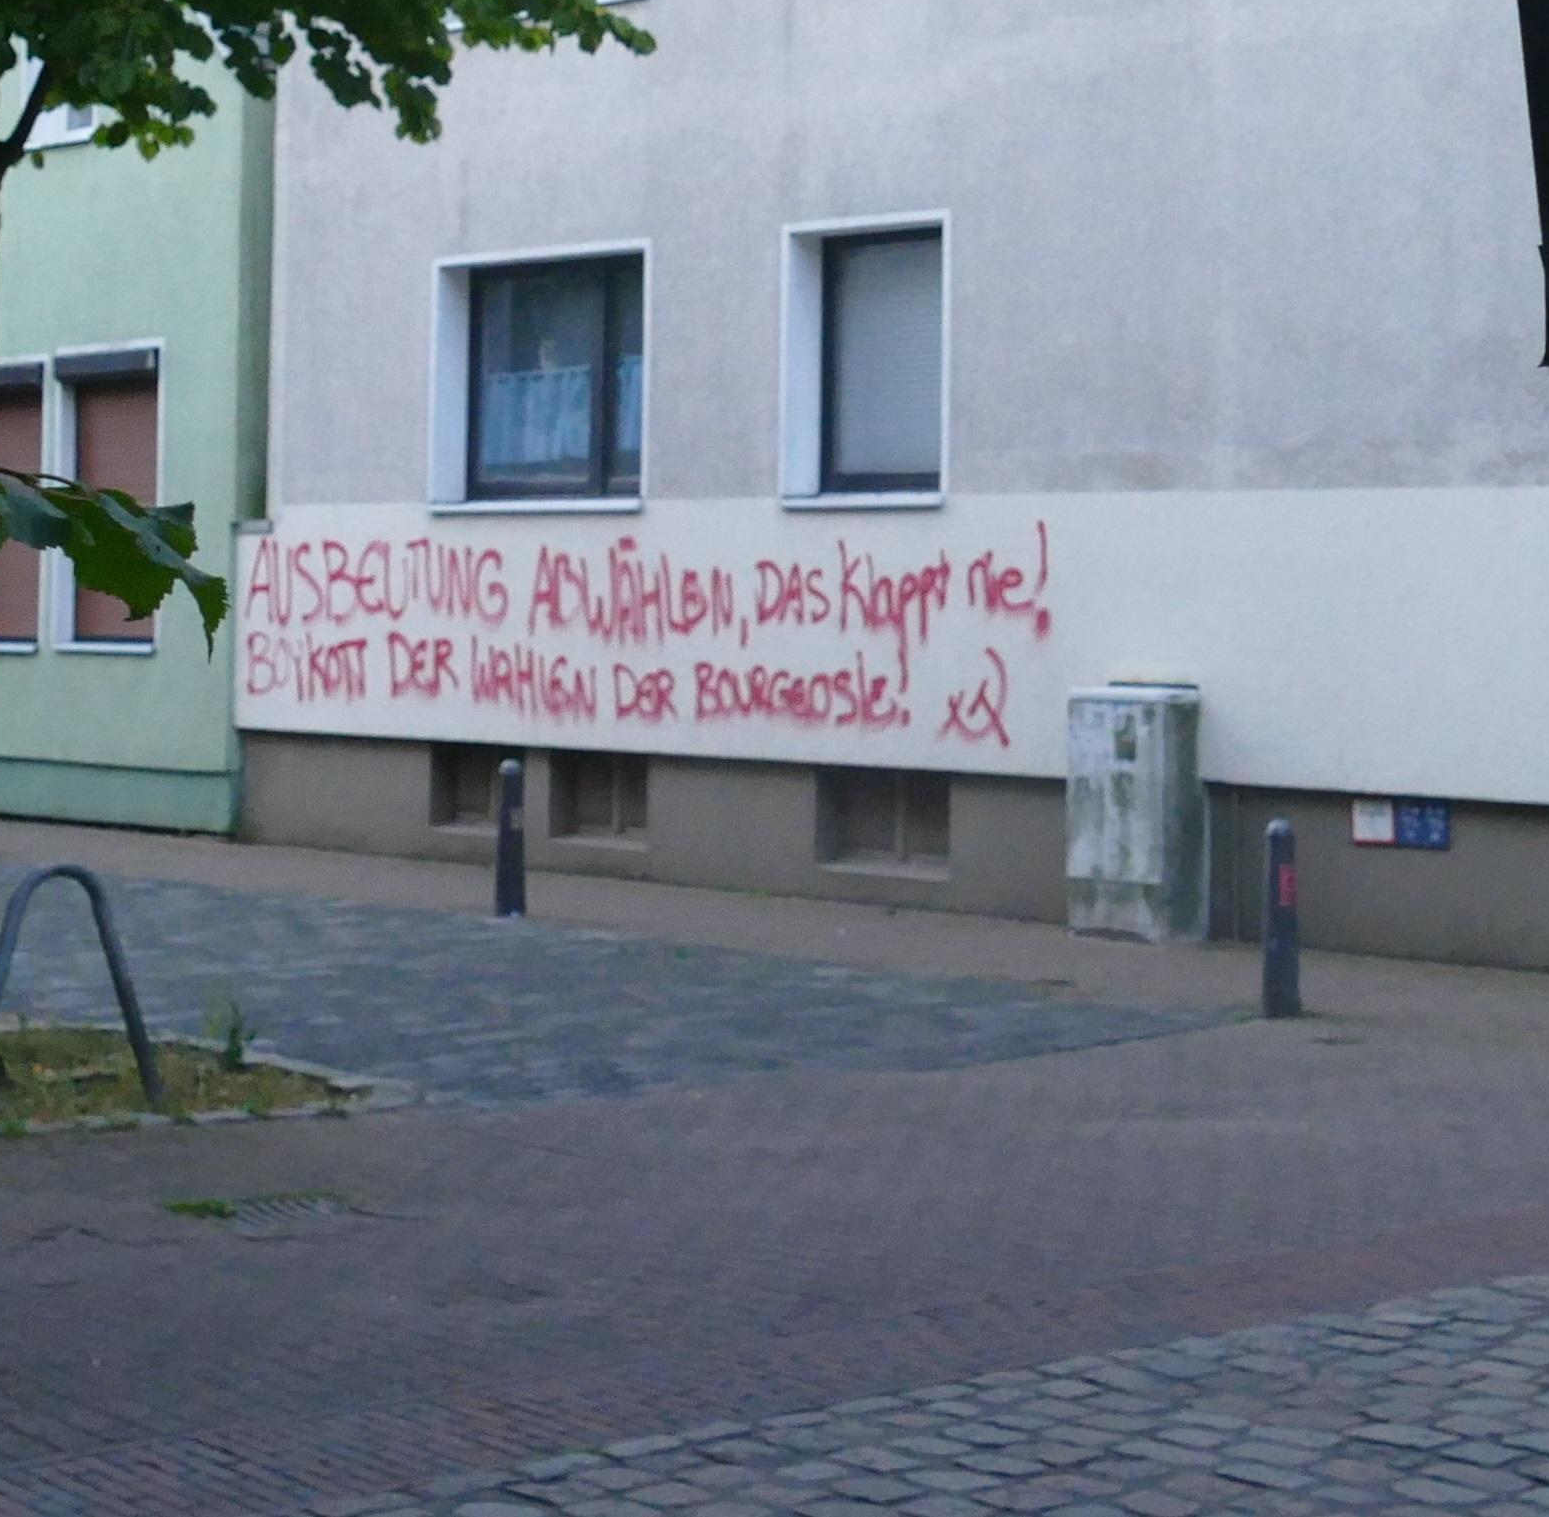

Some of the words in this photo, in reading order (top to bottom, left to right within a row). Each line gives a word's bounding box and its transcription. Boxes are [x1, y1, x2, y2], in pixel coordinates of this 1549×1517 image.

[245, 536, 509, 628] AUSBEUTUNG
[755, 559, 830, 625] DAS
[247, 630, 368, 703] BOYKOTT
[386, 632, 459, 698] DER
[471, 634, 597, 722] WAHLEN
[613, 662, 678, 722] DER
